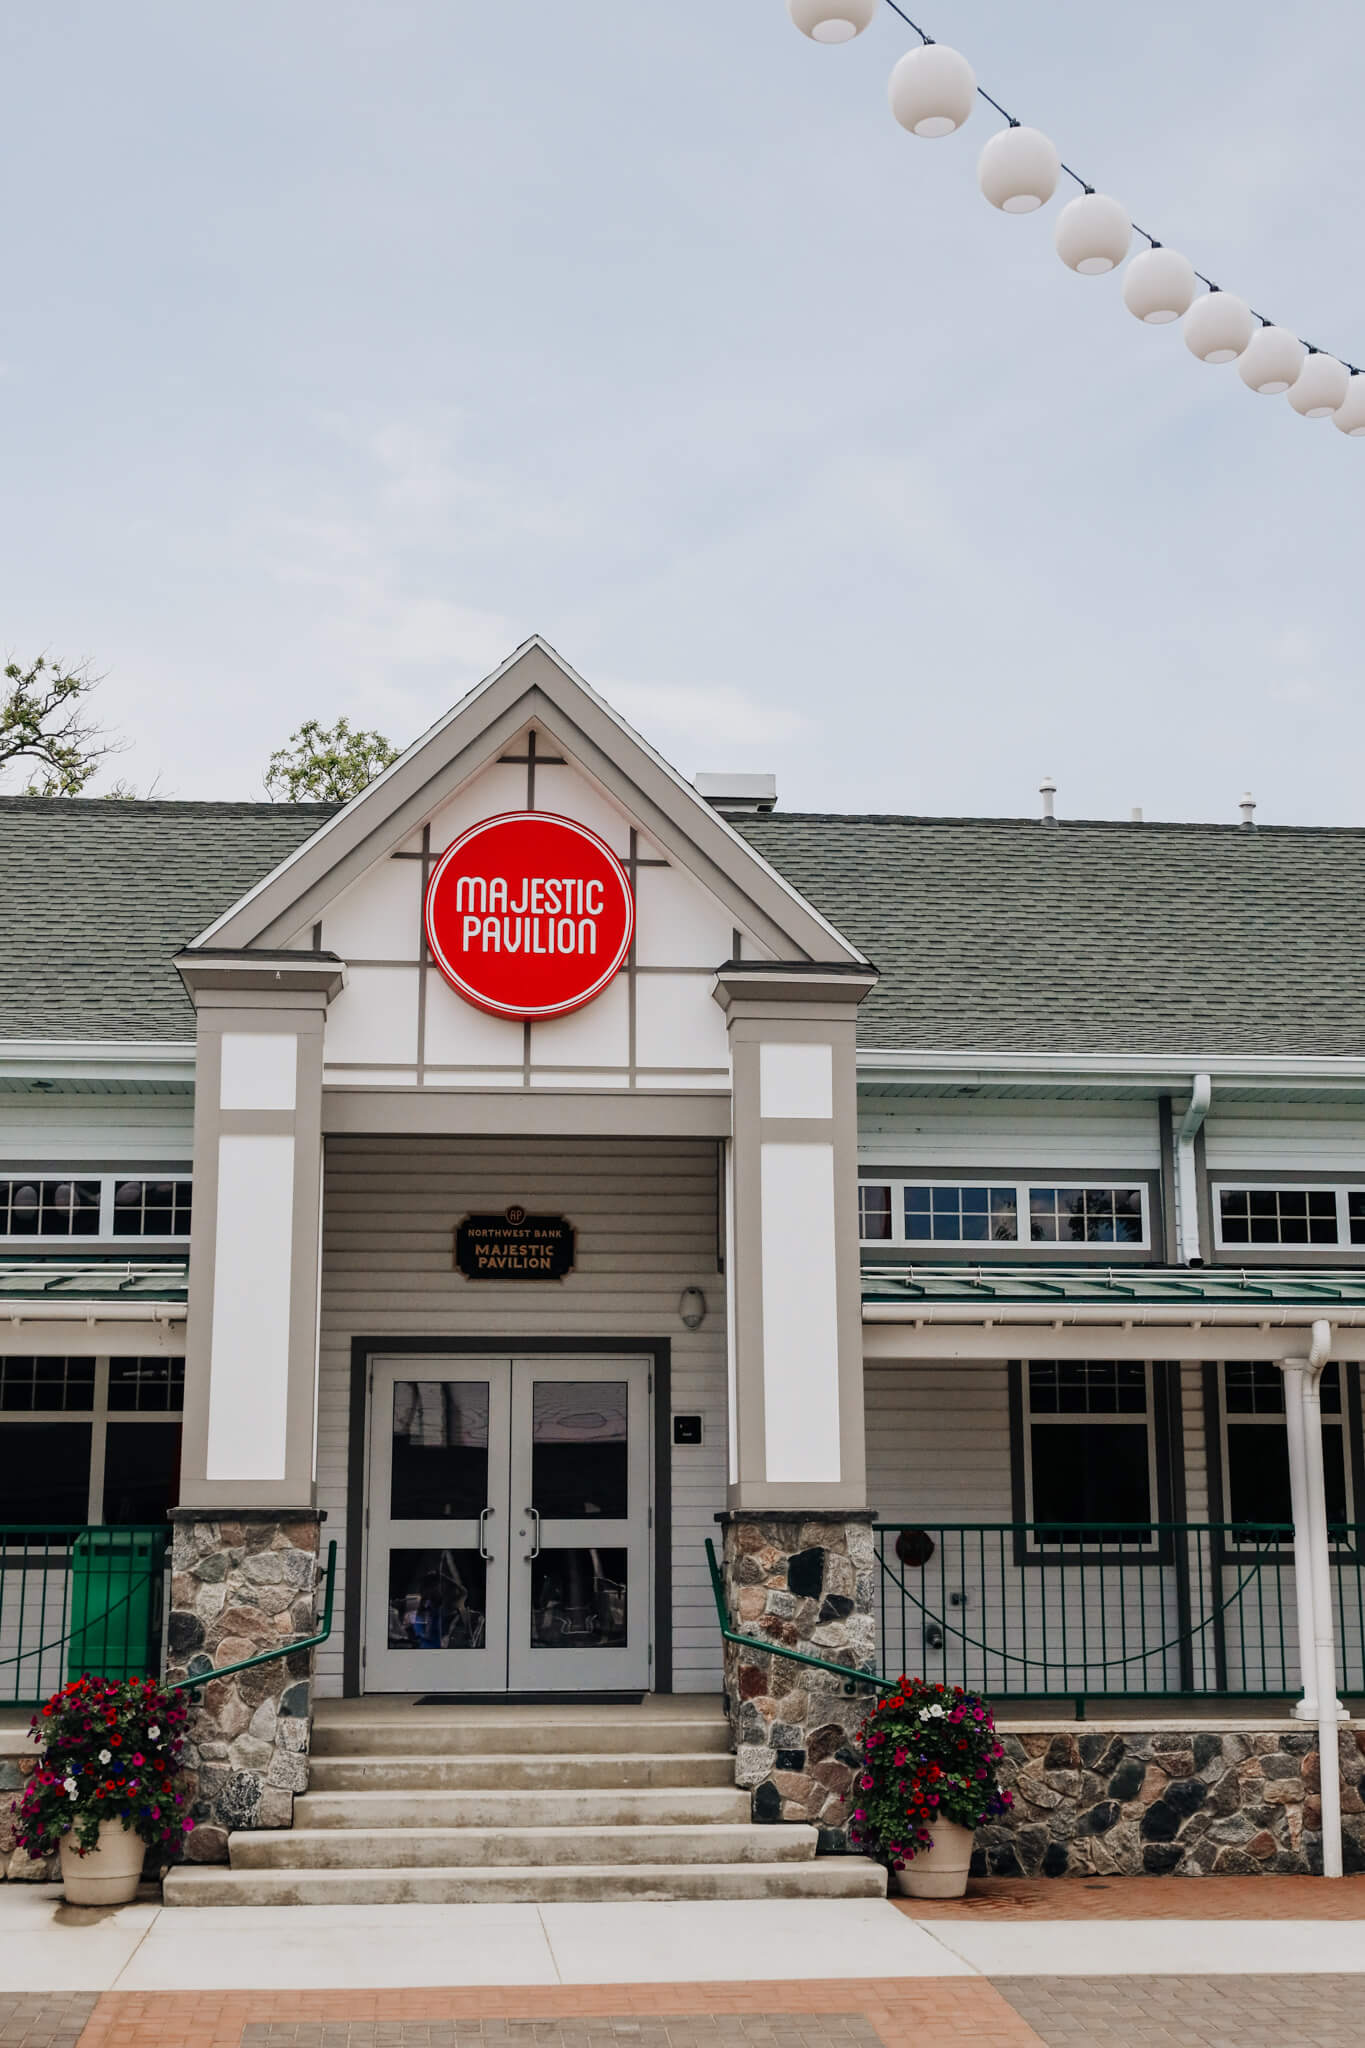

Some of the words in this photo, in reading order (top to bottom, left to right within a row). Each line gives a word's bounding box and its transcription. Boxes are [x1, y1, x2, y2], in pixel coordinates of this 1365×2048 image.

[456, 876, 604, 915] MAJESTIC
[463, 916, 597, 954] PAVILION
[468, 1229, 531, 1238] NORTHWEST
[534, 1230, 562, 1238] BANK
[475, 1244, 554, 1256] MAJESTIC
[479, 1257, 551, 1268] PAVILION
